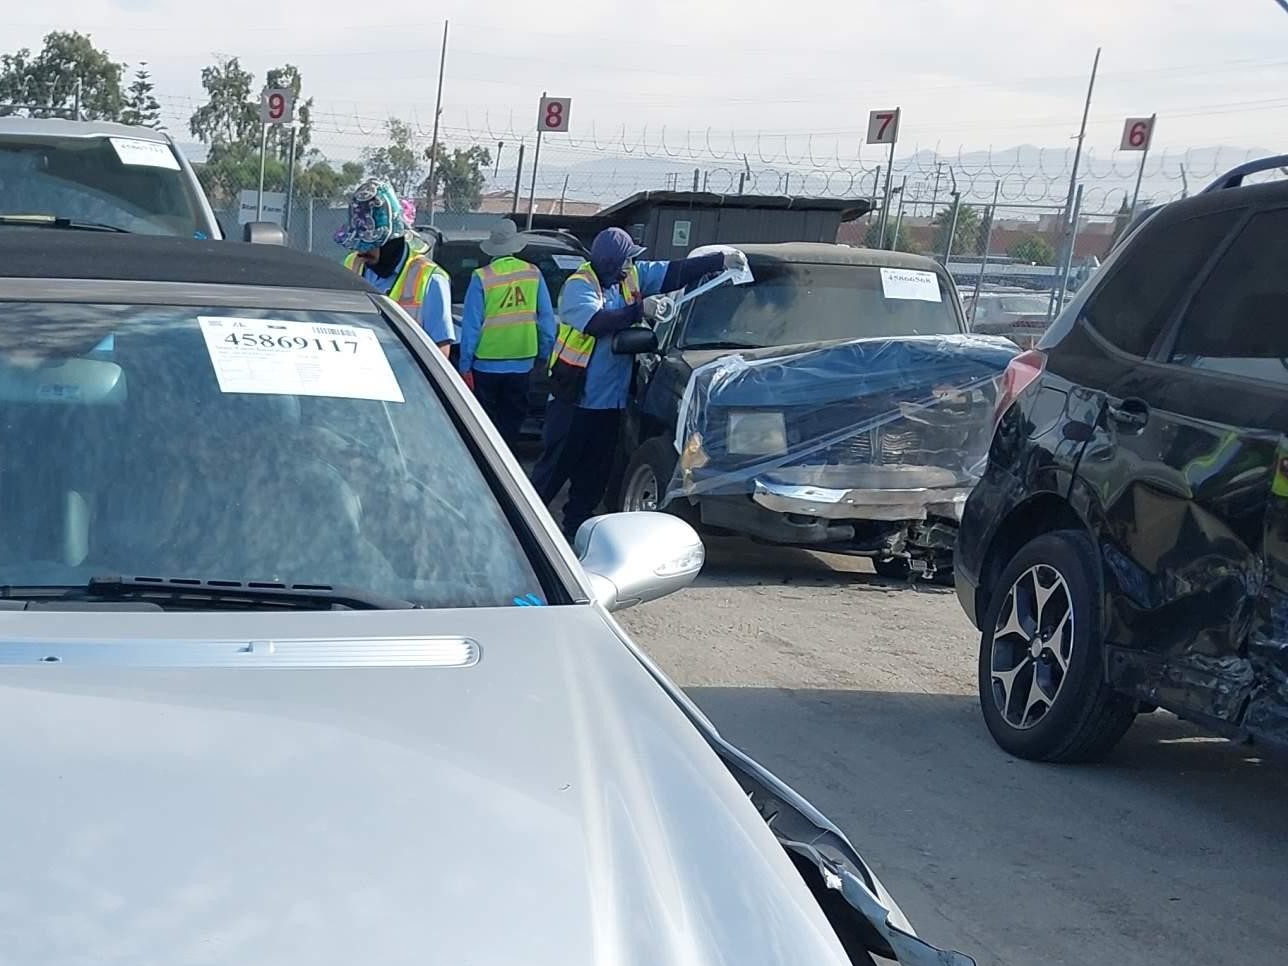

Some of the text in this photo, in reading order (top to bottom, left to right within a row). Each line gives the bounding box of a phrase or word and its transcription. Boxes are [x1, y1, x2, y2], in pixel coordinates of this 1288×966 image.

[269, 93, 285, 119] 9
[545, 101, 563, 128] 8
[875, 113, 894, 141] 7
[1128, 121, 1147, 147] 6
[224, 332, 358, 354] 45869117
